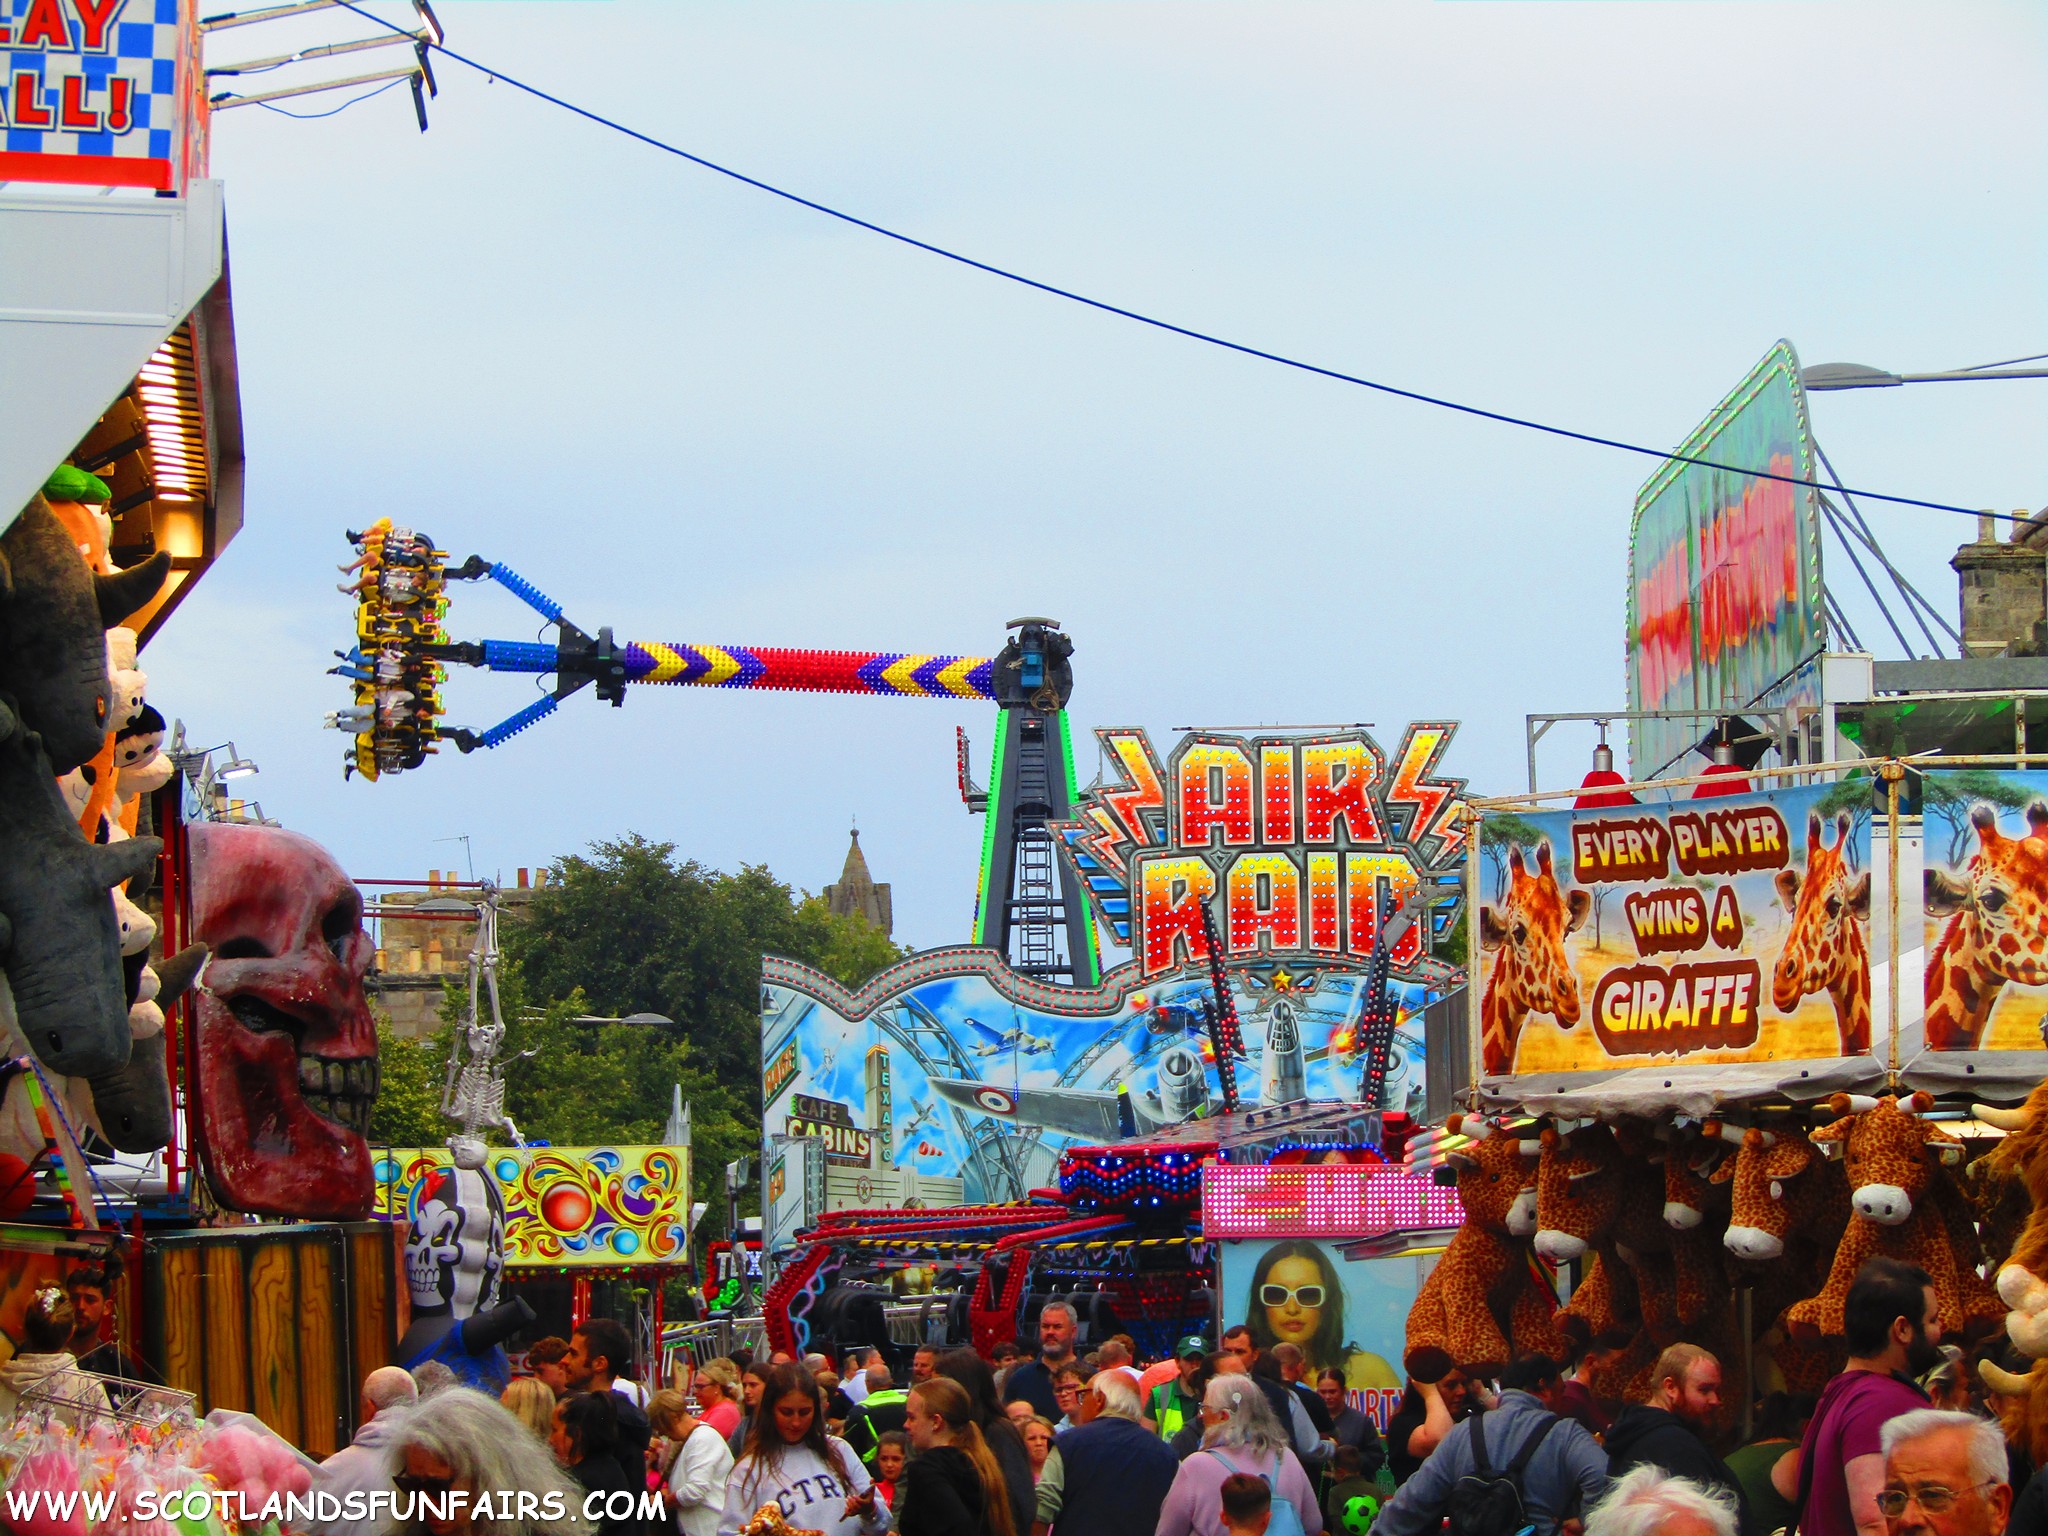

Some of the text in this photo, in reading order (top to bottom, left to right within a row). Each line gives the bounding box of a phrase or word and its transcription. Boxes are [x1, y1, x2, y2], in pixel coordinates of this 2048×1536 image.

[0, 70, 133, 135] LL!
[1177, 740, 1384, 848] AIR
[1577, 814, 1781, 868] EVERY PLAYER
[1140, 851, 1424, 978] RAID
[1630, 894, 1735, 937] WINS A
[1601, 972, 1754, 1032] GIRAFFE
[799, 1097, 837, 1120] CAFE
[880, 1053, 893, 1162] TEXACO
